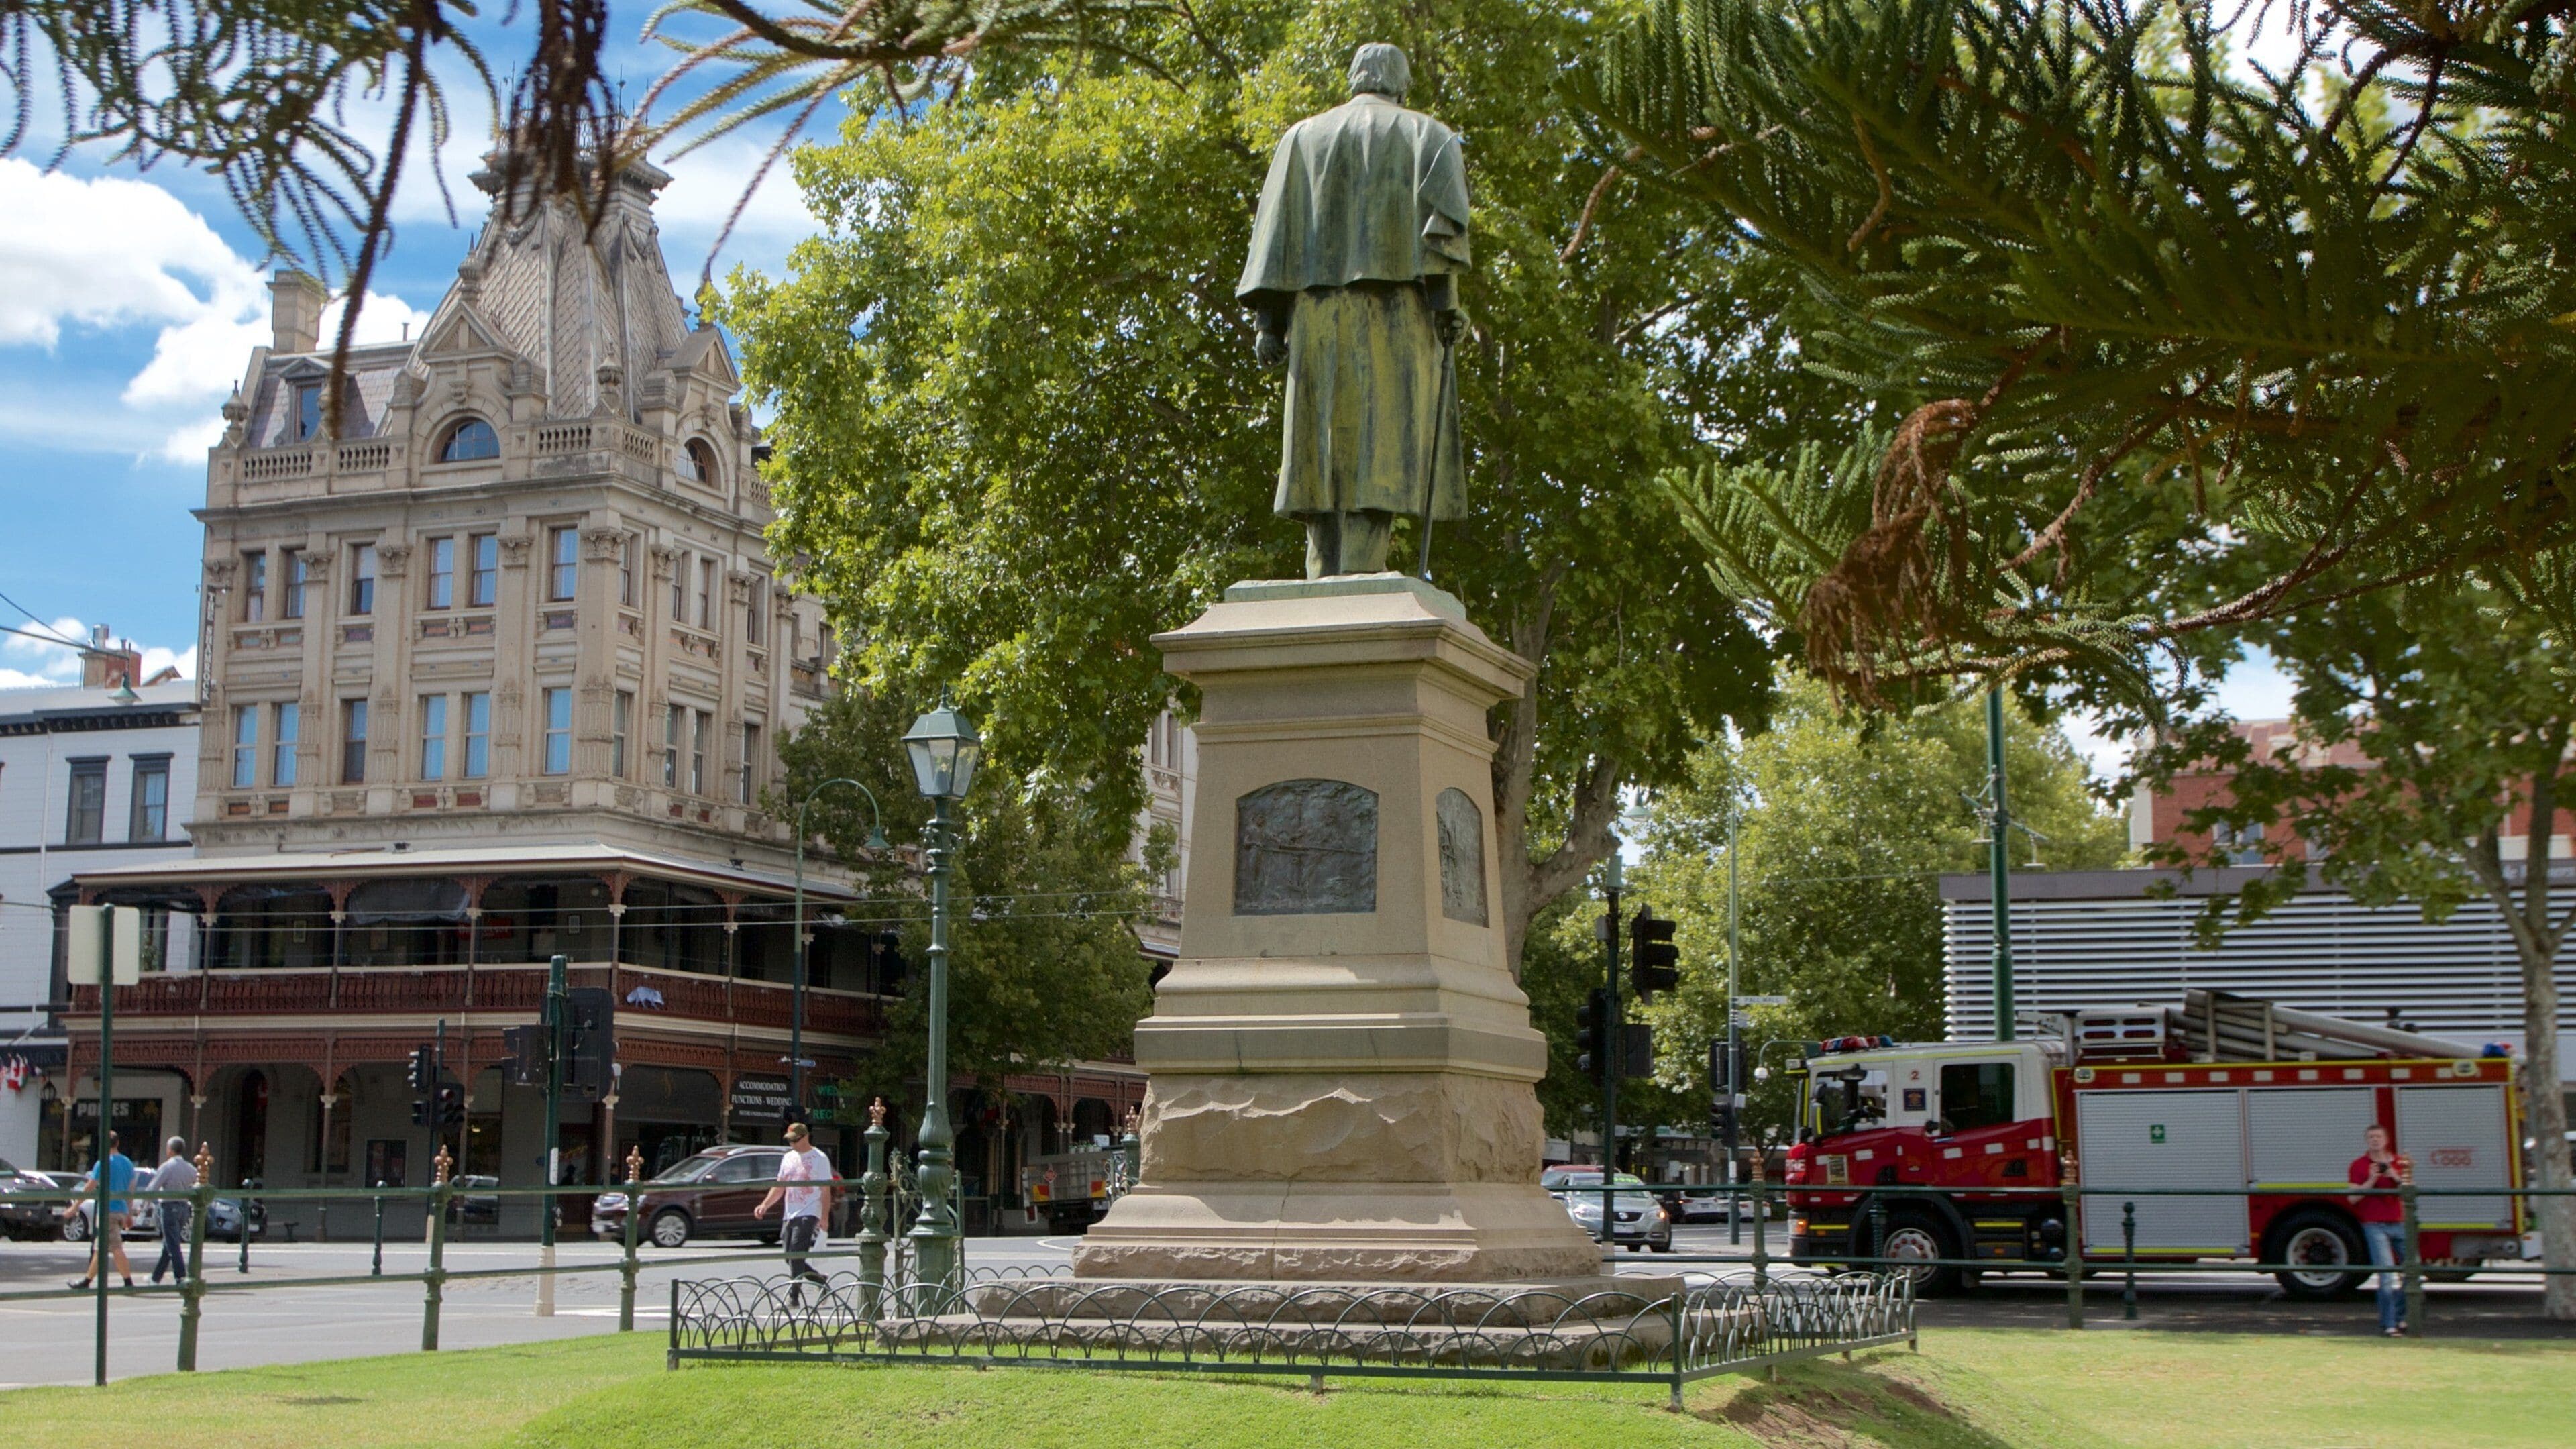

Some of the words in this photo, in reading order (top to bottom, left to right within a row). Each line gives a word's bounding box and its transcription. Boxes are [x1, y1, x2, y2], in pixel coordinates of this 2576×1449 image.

[207, 592, 215, 621] THE
[202, 625, 213, 700] SHAMROCK
[1910, 1071, 1919, 1081] 2
[739, 1081, 787, 1091] ACCOMMODATION
[732, 1094, 763, 1105] FUNCTIONS
[77, 1102, 129, 1116] POES
